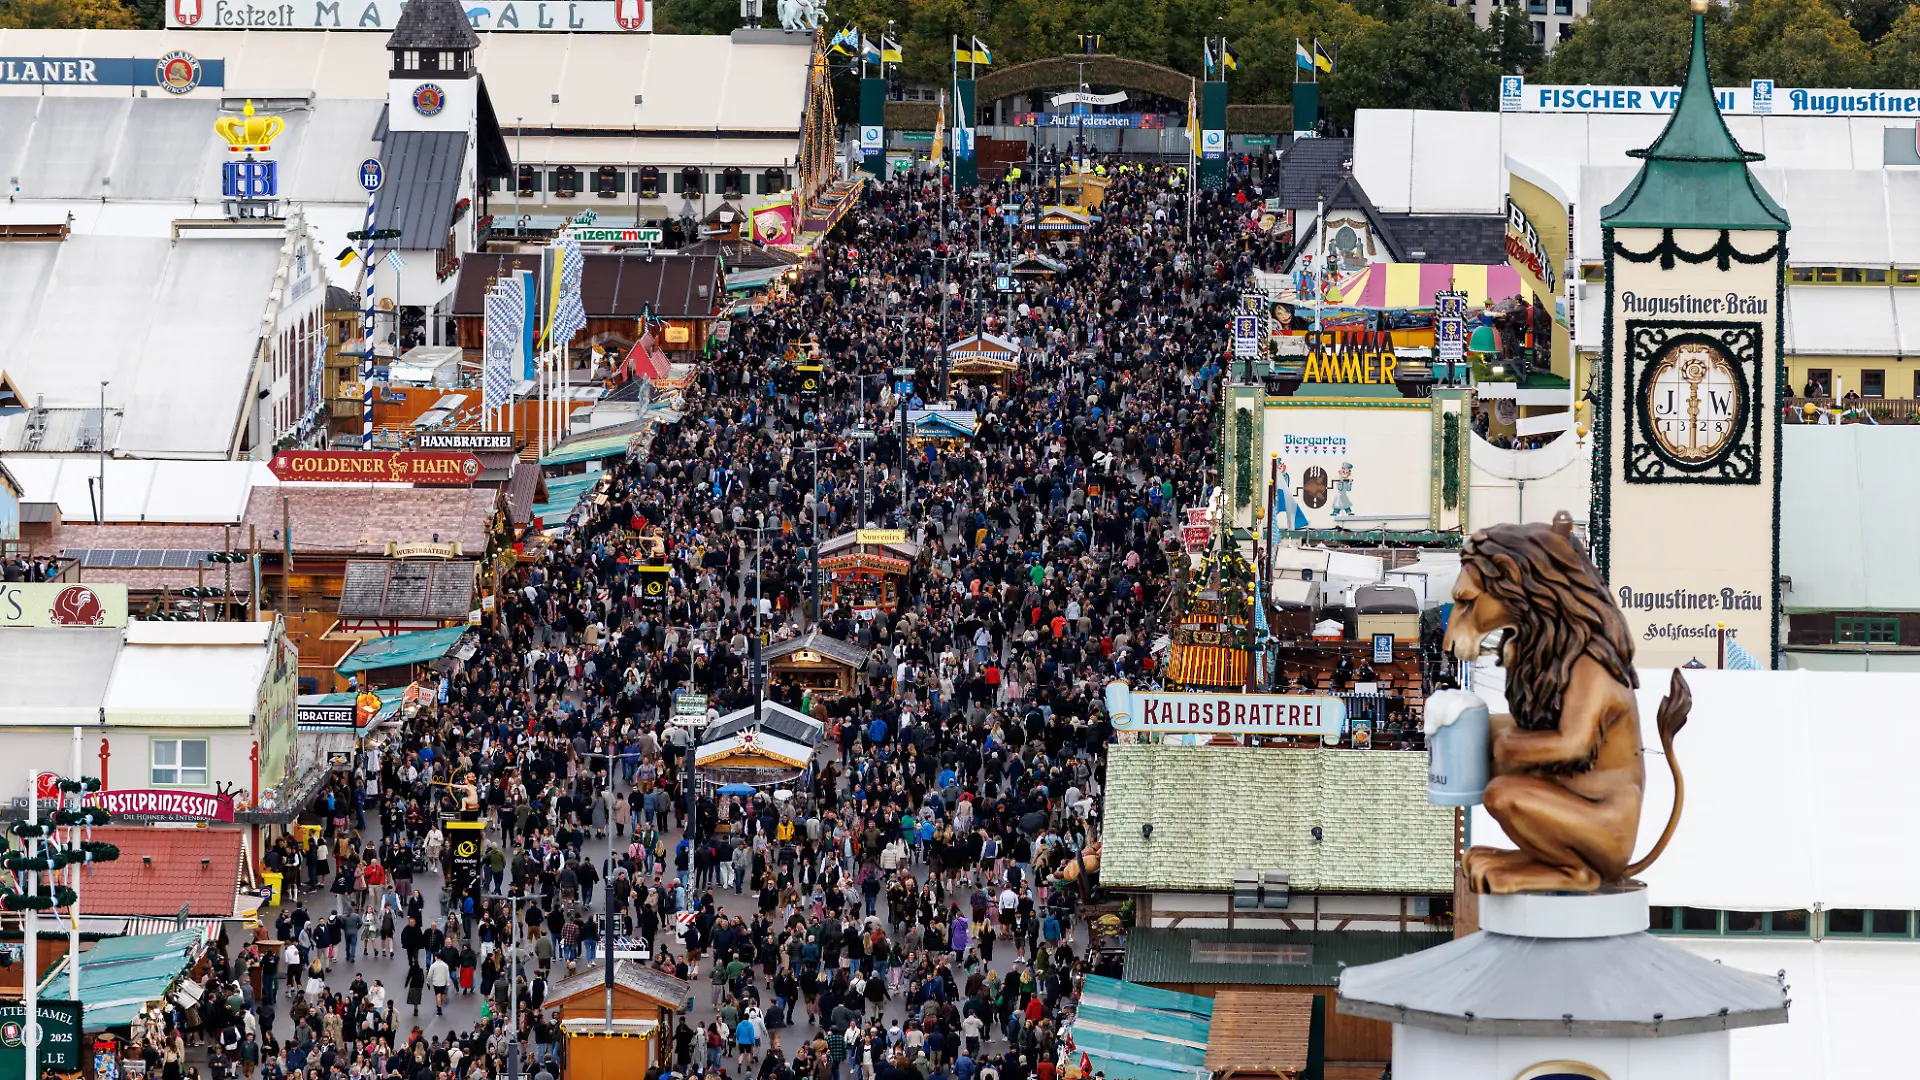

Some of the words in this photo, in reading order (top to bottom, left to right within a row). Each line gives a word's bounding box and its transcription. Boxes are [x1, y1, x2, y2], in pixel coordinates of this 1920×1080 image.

[158, 51, 199, 70] PAULANER
[0, 60, 98, 82] ULANER
[1540, 89, 1641, 108] FISCHER
[1789, 89, 1920, 114] Augustine
[364, 174, 379, 187] HB
[1303, 352, 1397, 384] AMMER
[420, 436, 512, 448] HAXNBRATEREI
[1284, 434, 1346, 447] Biergarten
[291, 457, 386, 474] GOLDENER
[412, 459, 461, 474] HAHN
[862, 533, 900, 541] Souvenirs
[396, 547, 451, 556] WURSTBRATEREI
[1643, 623, 1737, 641] Holzfasslaer
[1143, 699, 1321, 727] KALBSBRATEREI
[50, 1033, 73, 1042] 2025
